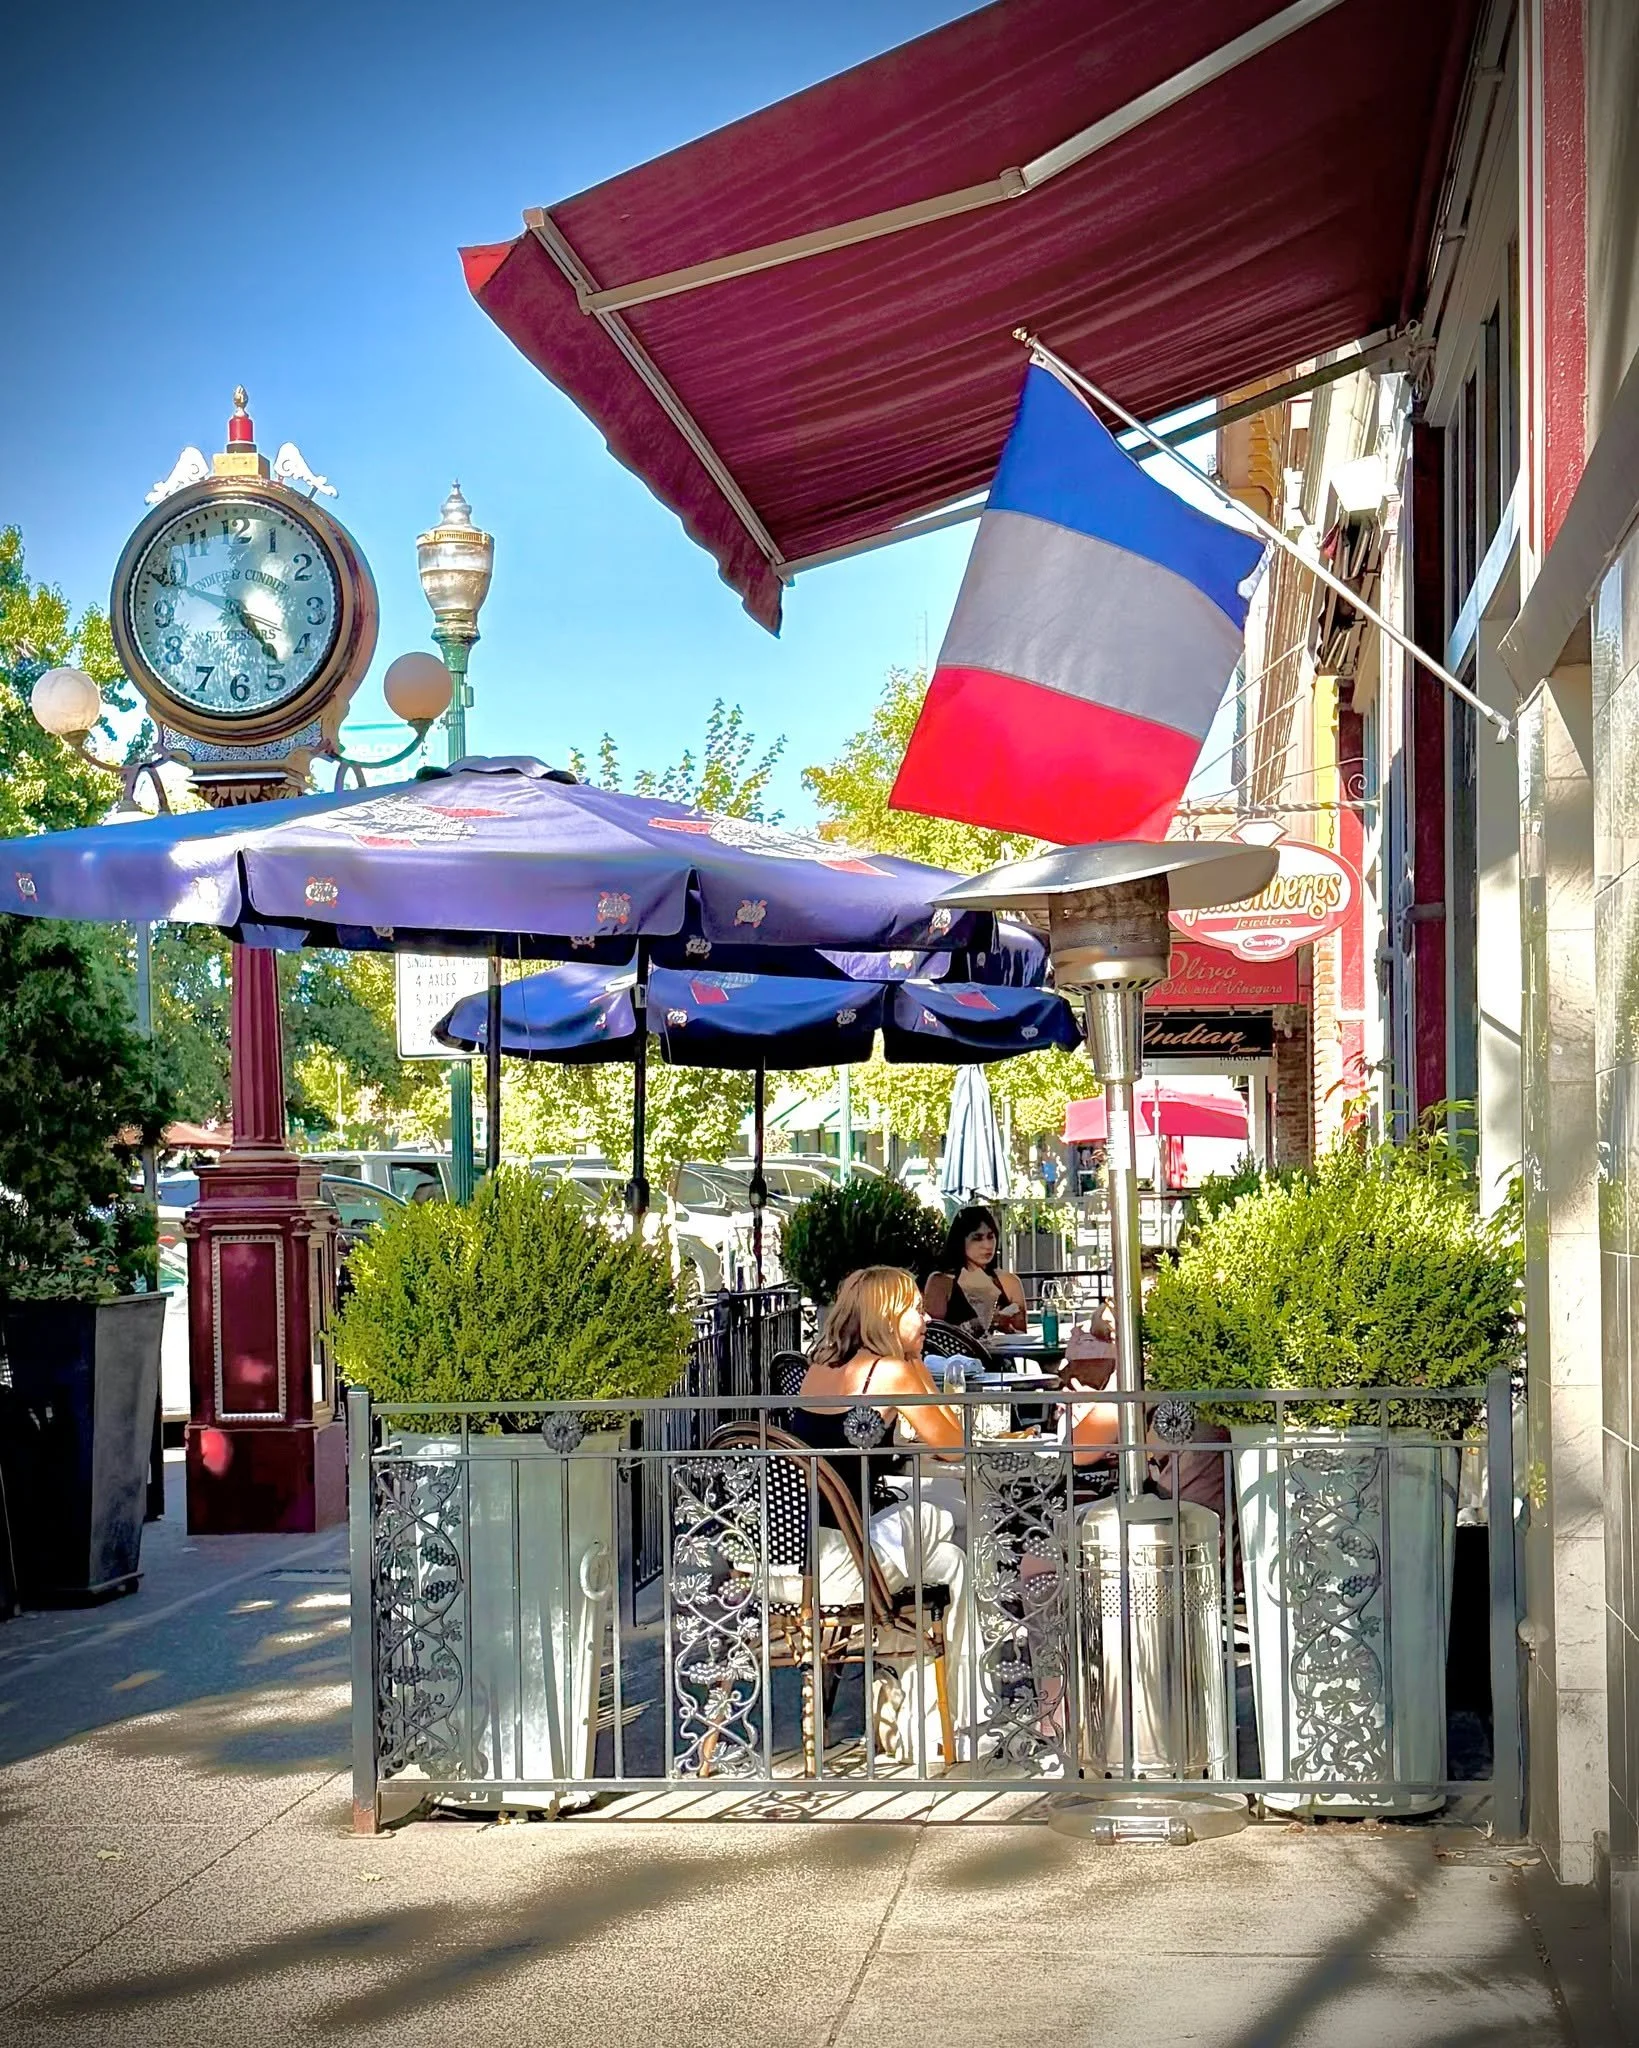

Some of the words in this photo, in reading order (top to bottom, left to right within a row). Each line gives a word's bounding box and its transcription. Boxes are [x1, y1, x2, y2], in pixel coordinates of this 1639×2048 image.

[187, 528, 209, 557] 11
[221, 517, 253, 545] 12
[267, 527, 277, 554] 1
[293, 553, 313, 582] 2
[153, 600, 175, 628] 9
[306, 597, 327, 625] 3
[206, 628, 276, 642] SUCCESSRS
[294, 632, 312, 661] 4
[165, 636, 184, 665] 8
[194, 666, 215, 692] 7
[229, 673, 250, 701] 6
[265, 663, 286, 691] 5
[1184, 873, 1341, 926] nbergs
[1143, 1021, 1247, 1045] Indian
